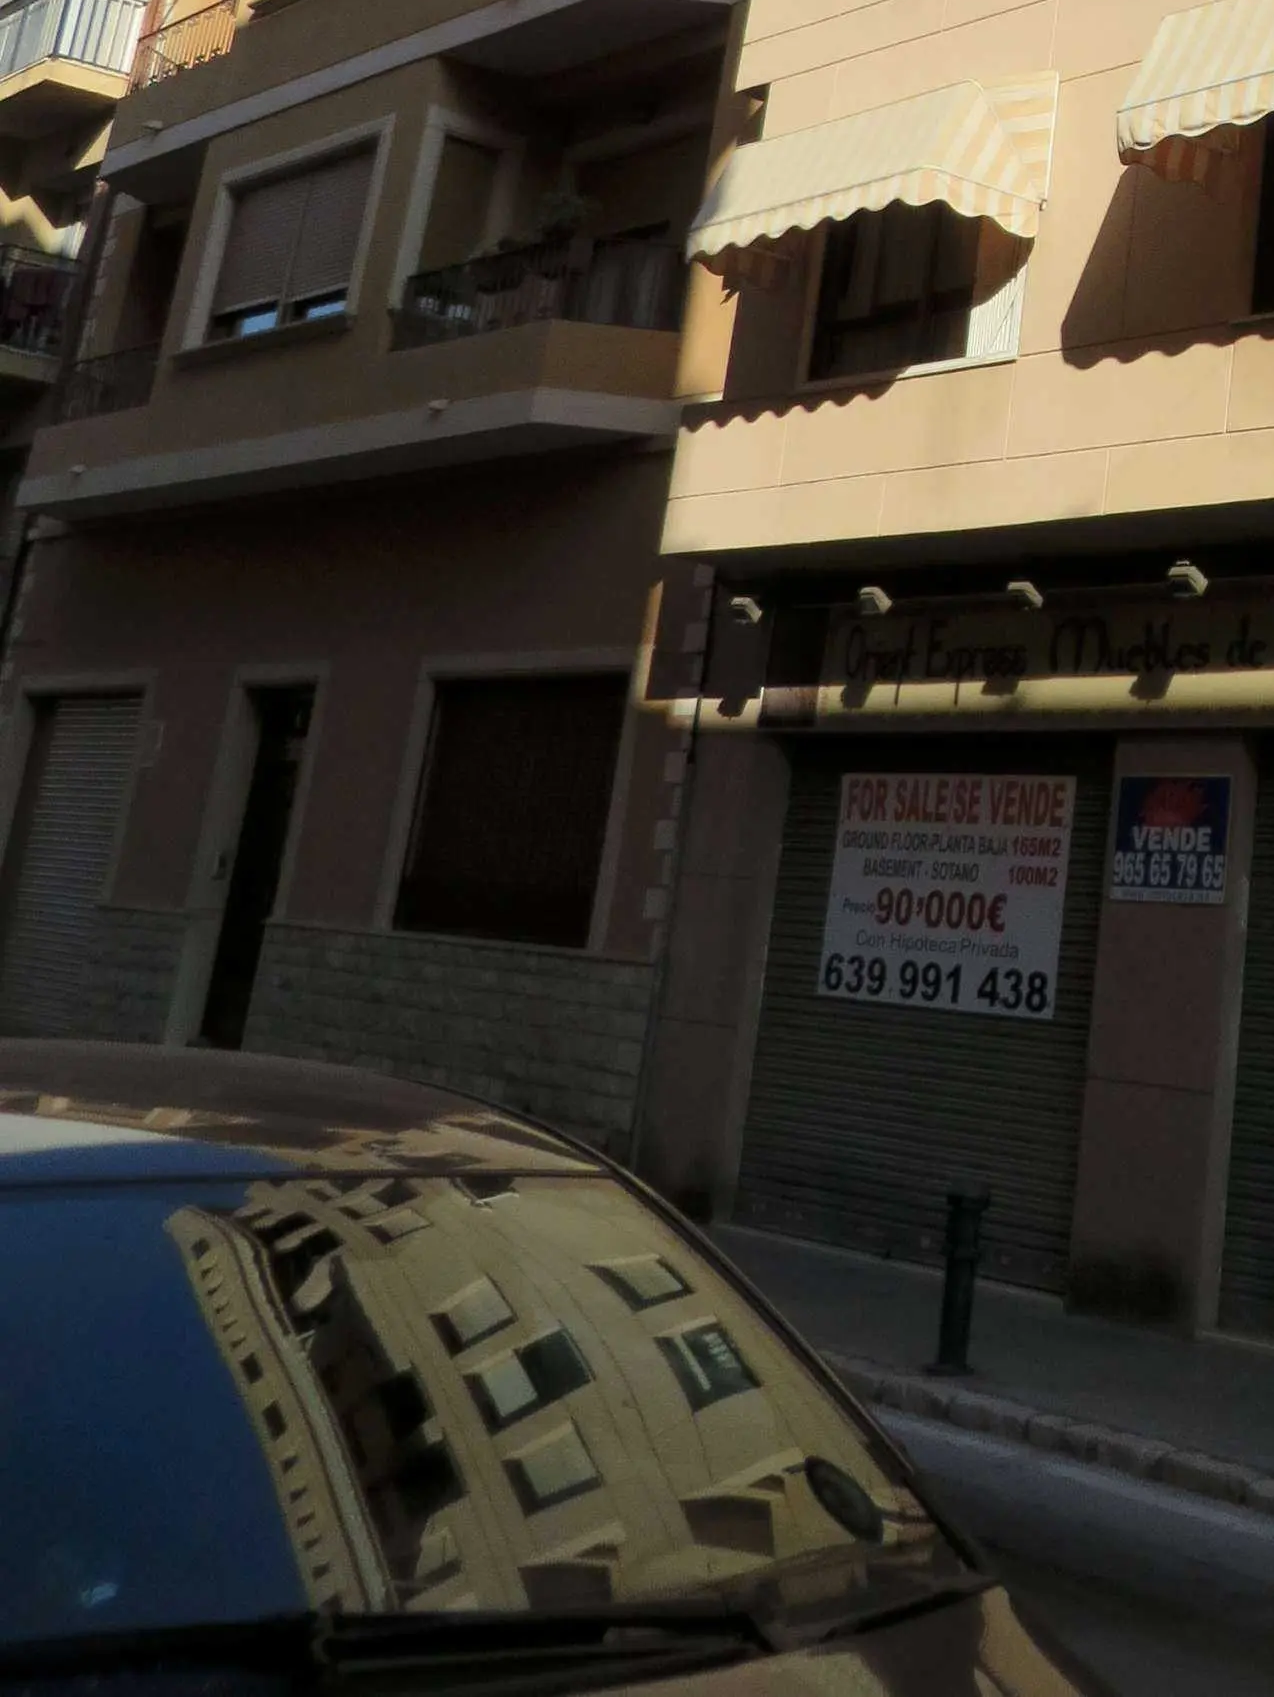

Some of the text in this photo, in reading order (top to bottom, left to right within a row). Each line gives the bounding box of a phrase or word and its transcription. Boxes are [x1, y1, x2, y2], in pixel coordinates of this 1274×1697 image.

[1049, 615, 1212, 676] Muebles
[1225, 612, 1268, 668] de
[846, 778, 887, 822] FOR
[989, 778, 1067, 827] VENDE
[842, 830, 888, 850] GROUND
[1132, 825, 1211, 852] VENDE
[863, 857, 923, 880] BASEMENT
[1008, 866, 1058, 887] 100M2
[1113, 850, 1224, 888] 965 65 79 65
[856, 929, 1019, 958] Con Hipoteca Privada
[824, 952, 1048, 1013] 639 991 438
